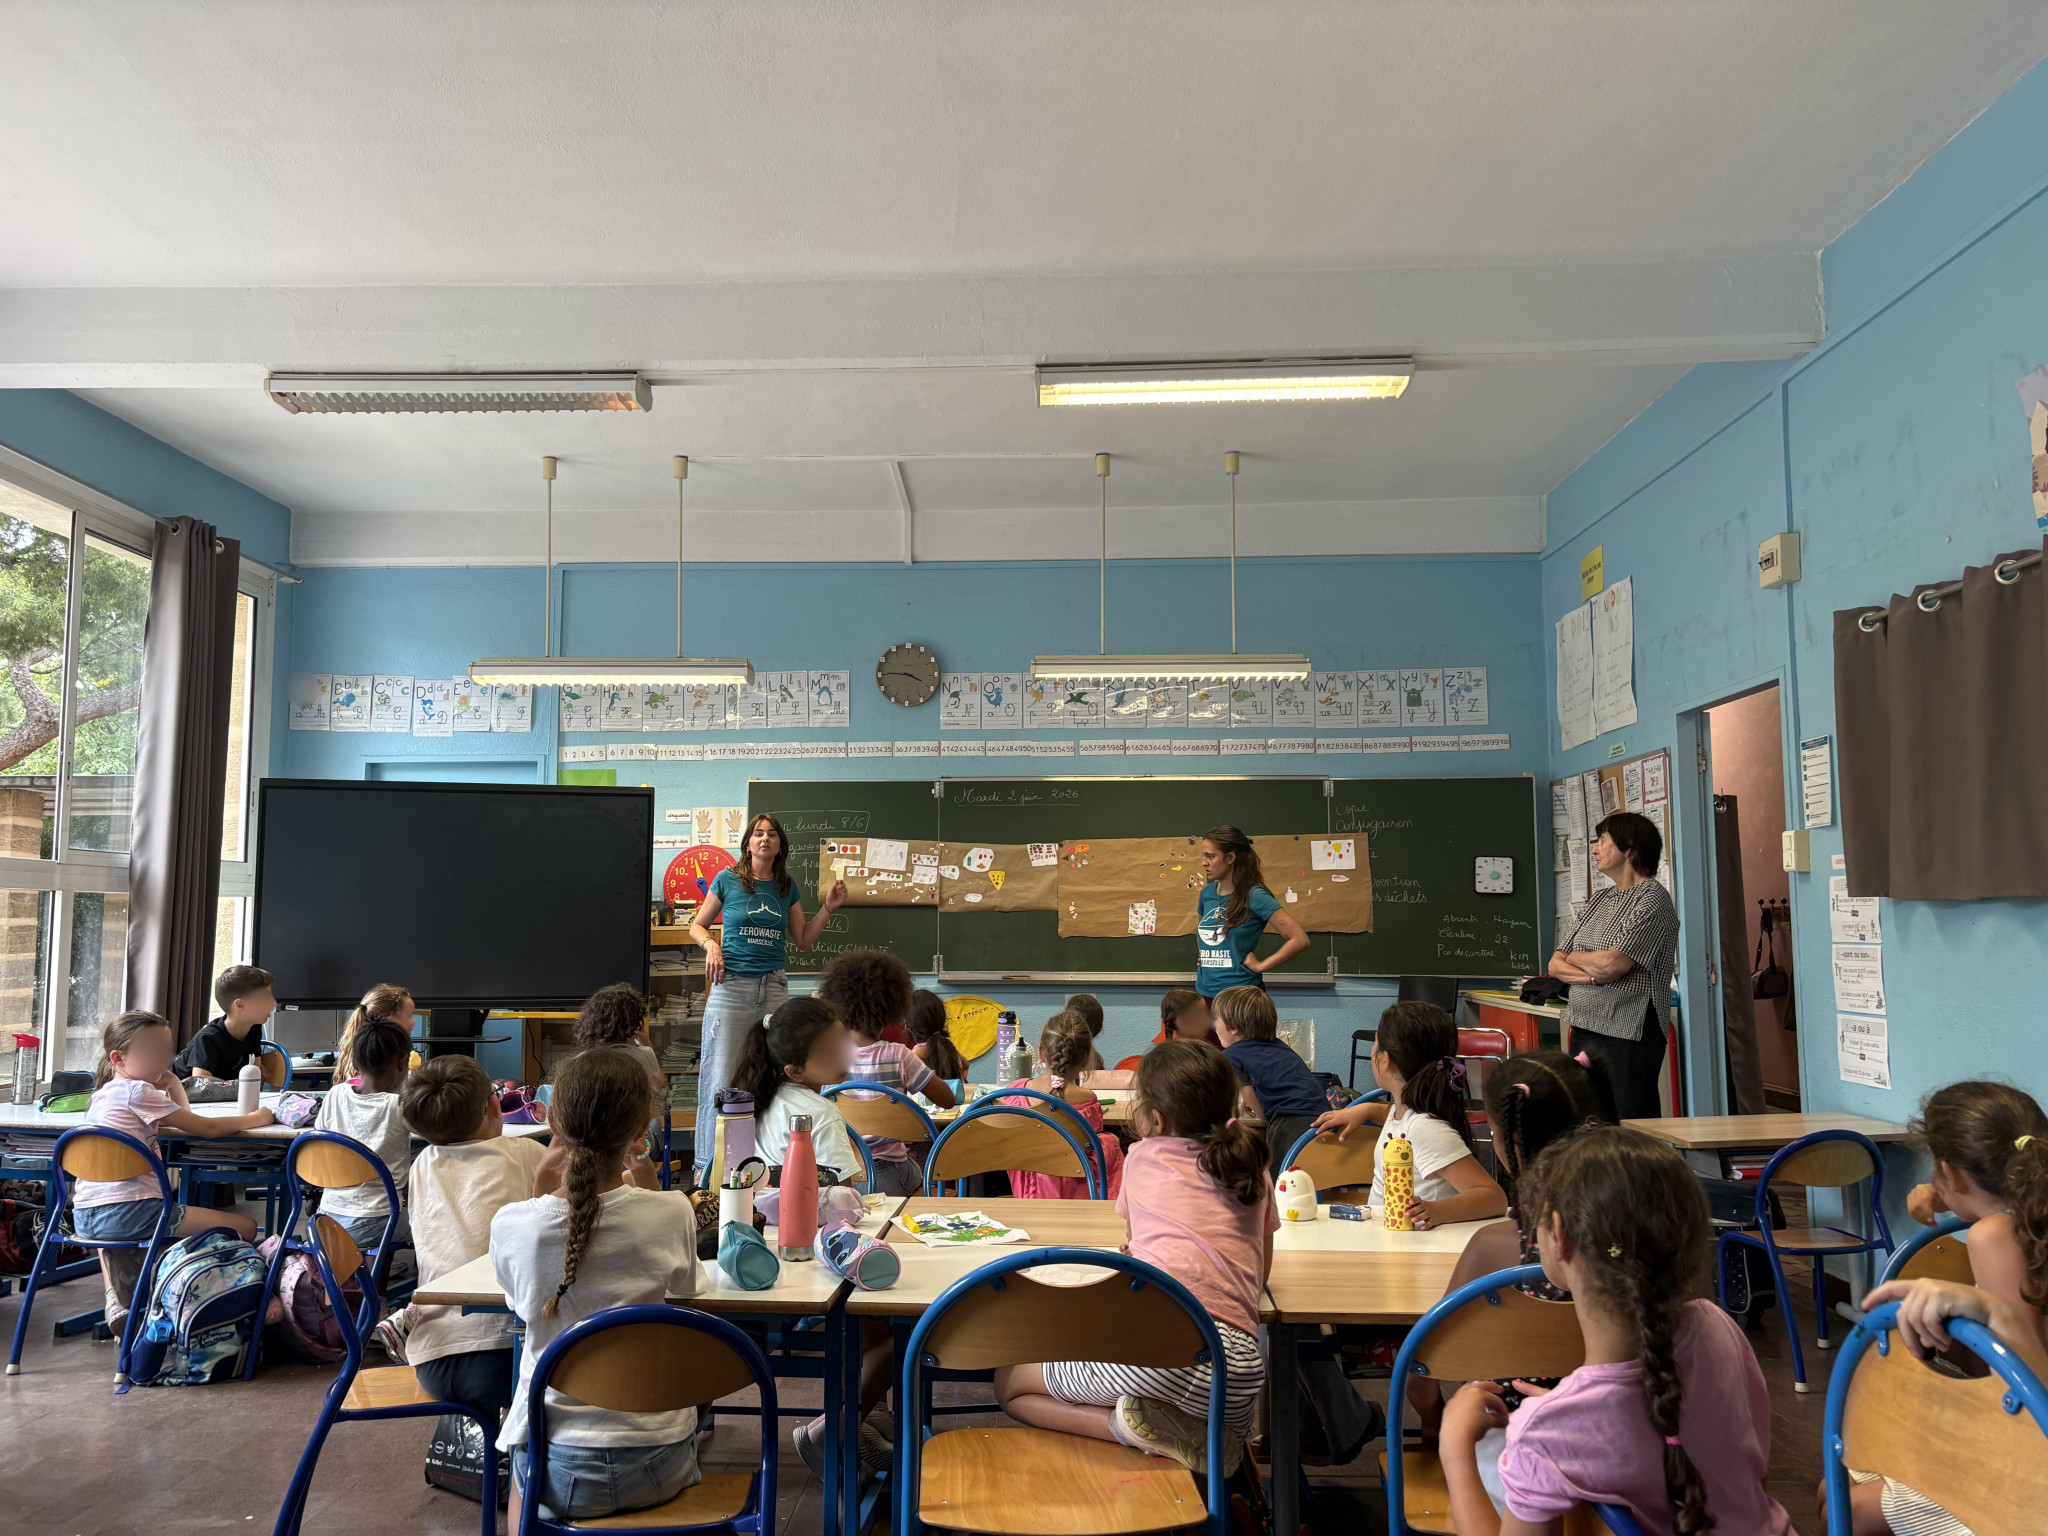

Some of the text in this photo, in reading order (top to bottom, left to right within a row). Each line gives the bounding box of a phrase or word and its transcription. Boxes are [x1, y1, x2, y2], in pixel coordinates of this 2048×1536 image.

[954, 788, 1079, 805] Mardi 2 juin 2026
[1335, 803, 1370, 820] Copie
[795, 816, 835, 832] lundi
[841, 816, 864, 828] 8/6
[683, 856, 695, 866] 11
[698, 852, 709, 860] 12
[715, 856, 719, 864] 1
[674, 867, 685, 876] 10
[670, 879, 676, 888] 9
[1372, 873, 1421, 888] vention
[674, 893, 680, 902] 8
[1443, 914, 1478, 924] Absents
[1438, 926, 1509, 944] Cantine 22
[747, 937, 774, 947] MARSEILLE
[1211, 949, 1230, 958] WASTE
[1436, 943, 1452, 957] Pas
[1464, 949, 1496, 959] cantine
[1510, 950, 1529, 961] KIM
